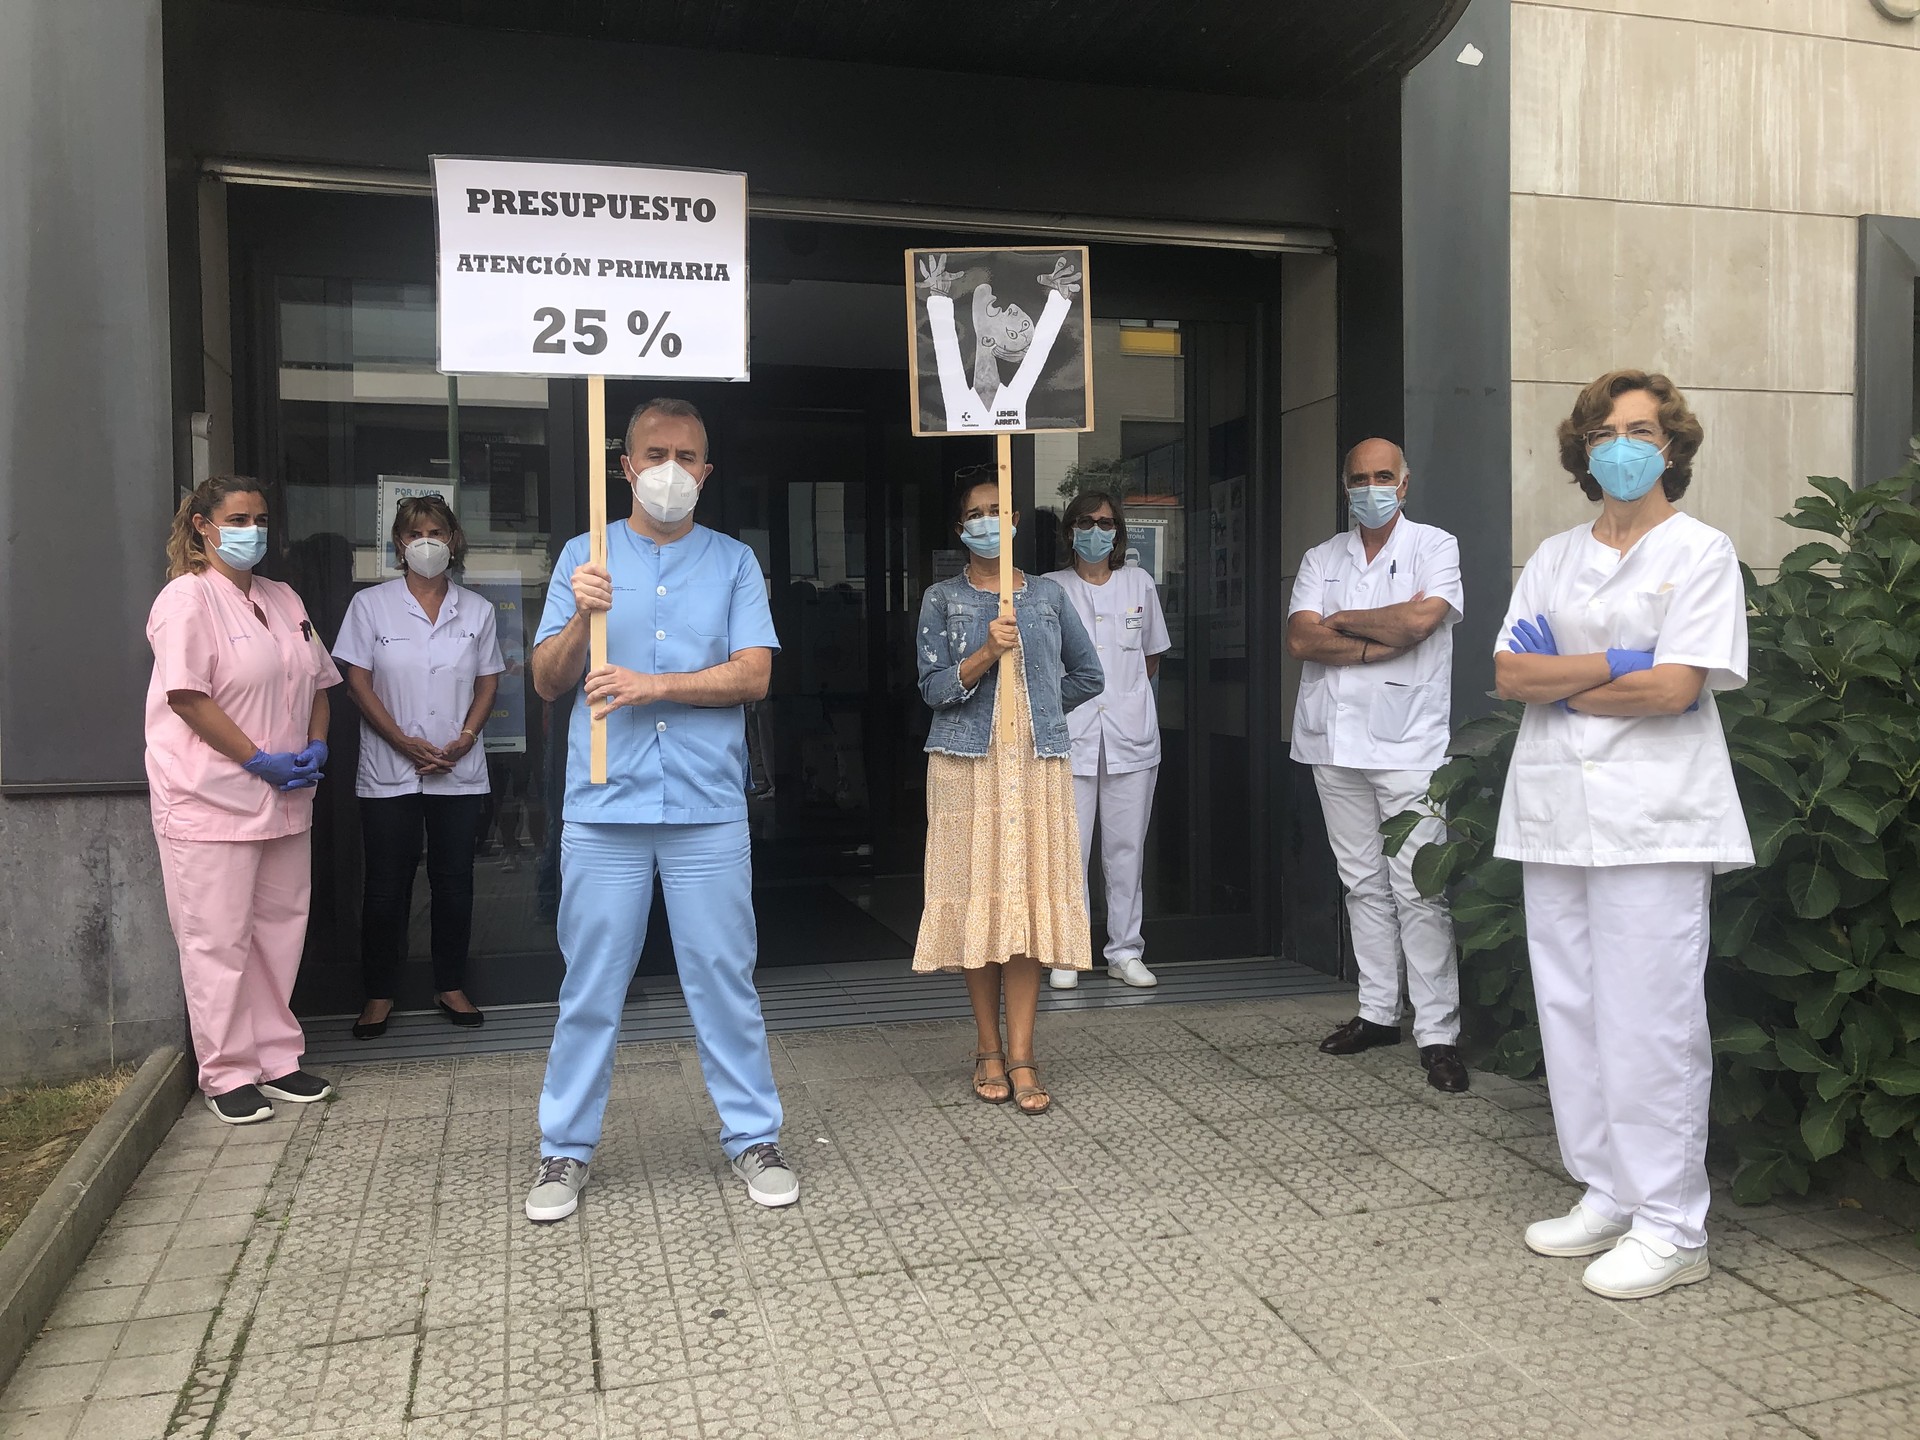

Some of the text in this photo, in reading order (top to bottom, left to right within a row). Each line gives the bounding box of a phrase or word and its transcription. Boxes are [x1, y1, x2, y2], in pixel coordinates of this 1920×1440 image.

[466, 188, 716, 222] PRESUPUESTO
[457, 253, 730, 282] ATENCIÓN PRIMARIA
[533, 307, 682, 358] 25 %
[395, 487, 412, 496] POR
